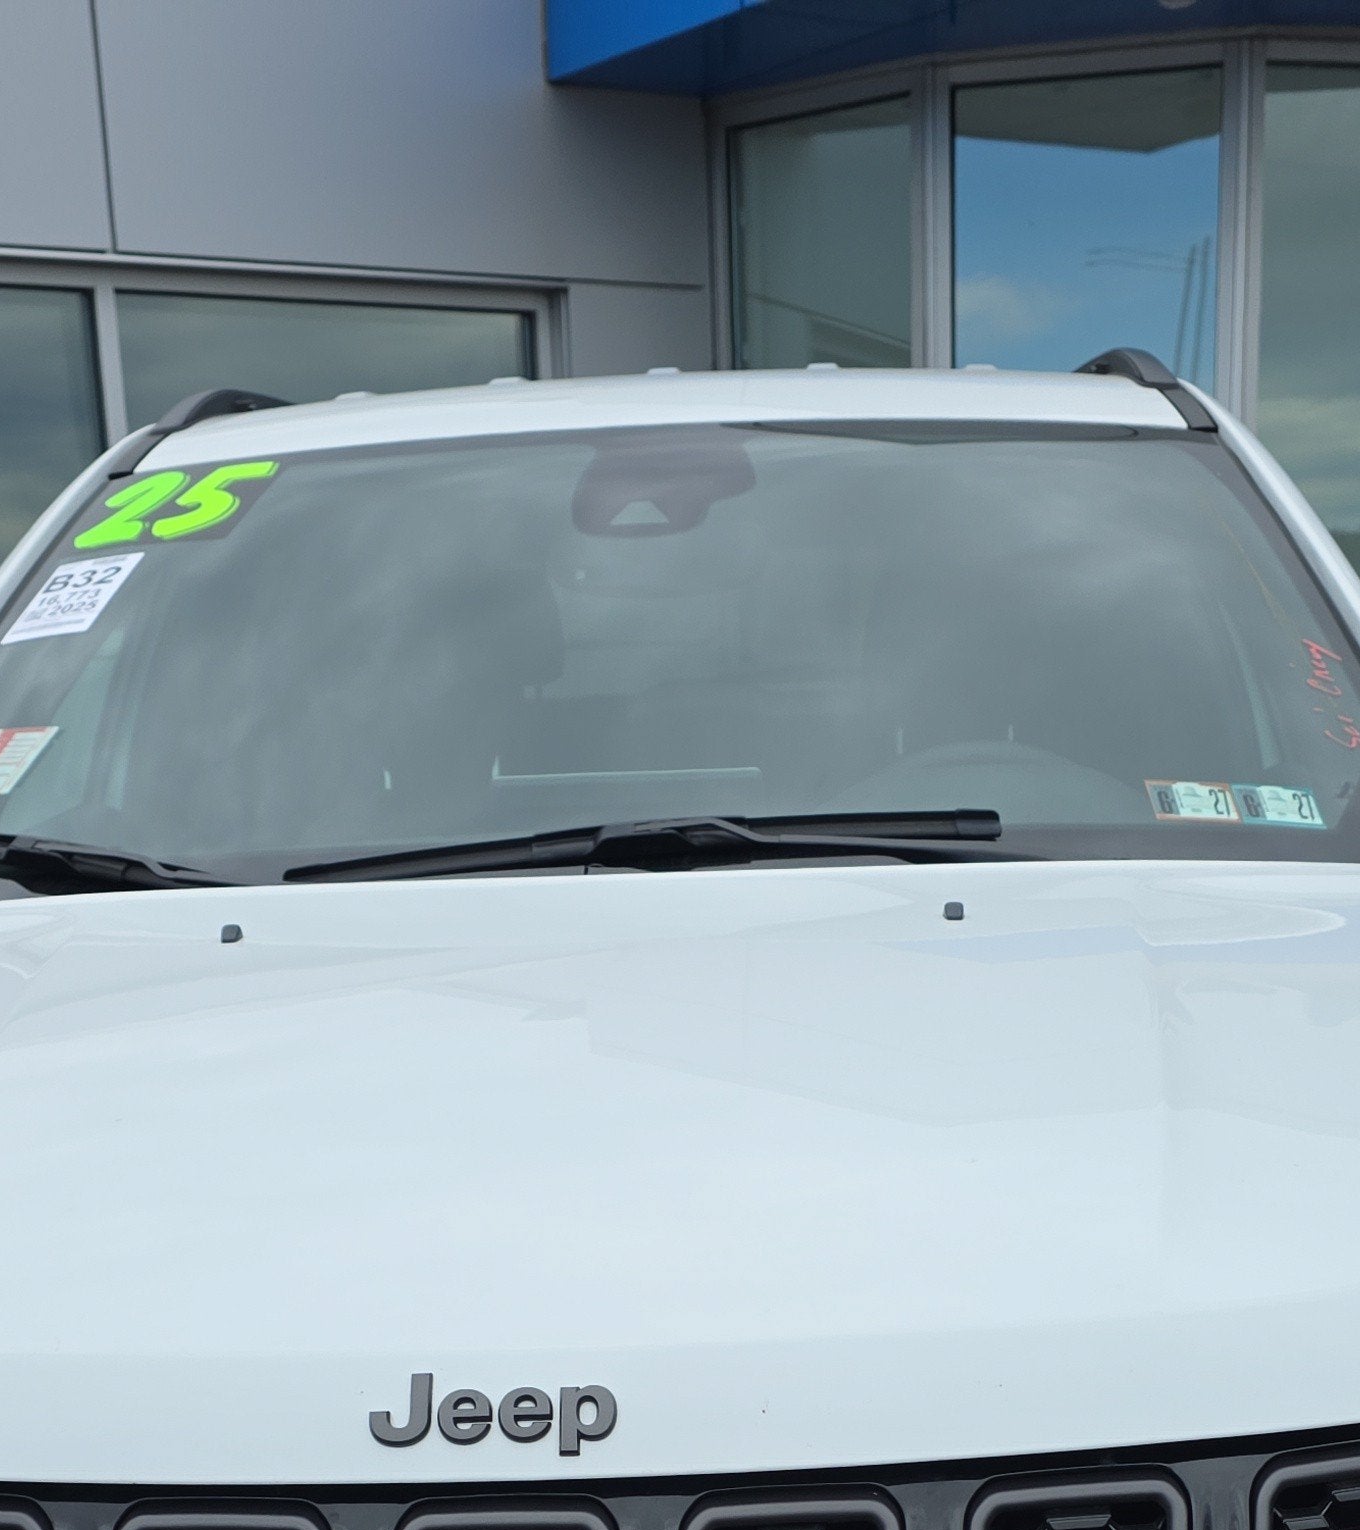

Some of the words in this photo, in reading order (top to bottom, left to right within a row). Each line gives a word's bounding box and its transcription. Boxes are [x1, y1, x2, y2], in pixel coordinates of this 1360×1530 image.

[73, 460, 280, 550] 25
[42, 566, 123, 594] B32
[48, 600, 98, 617] 2025
[1208, 788, 1231, 817] 27
[1292, 792, 1316, 821] 27
[368, 1372, 618, 1457] Jeep
